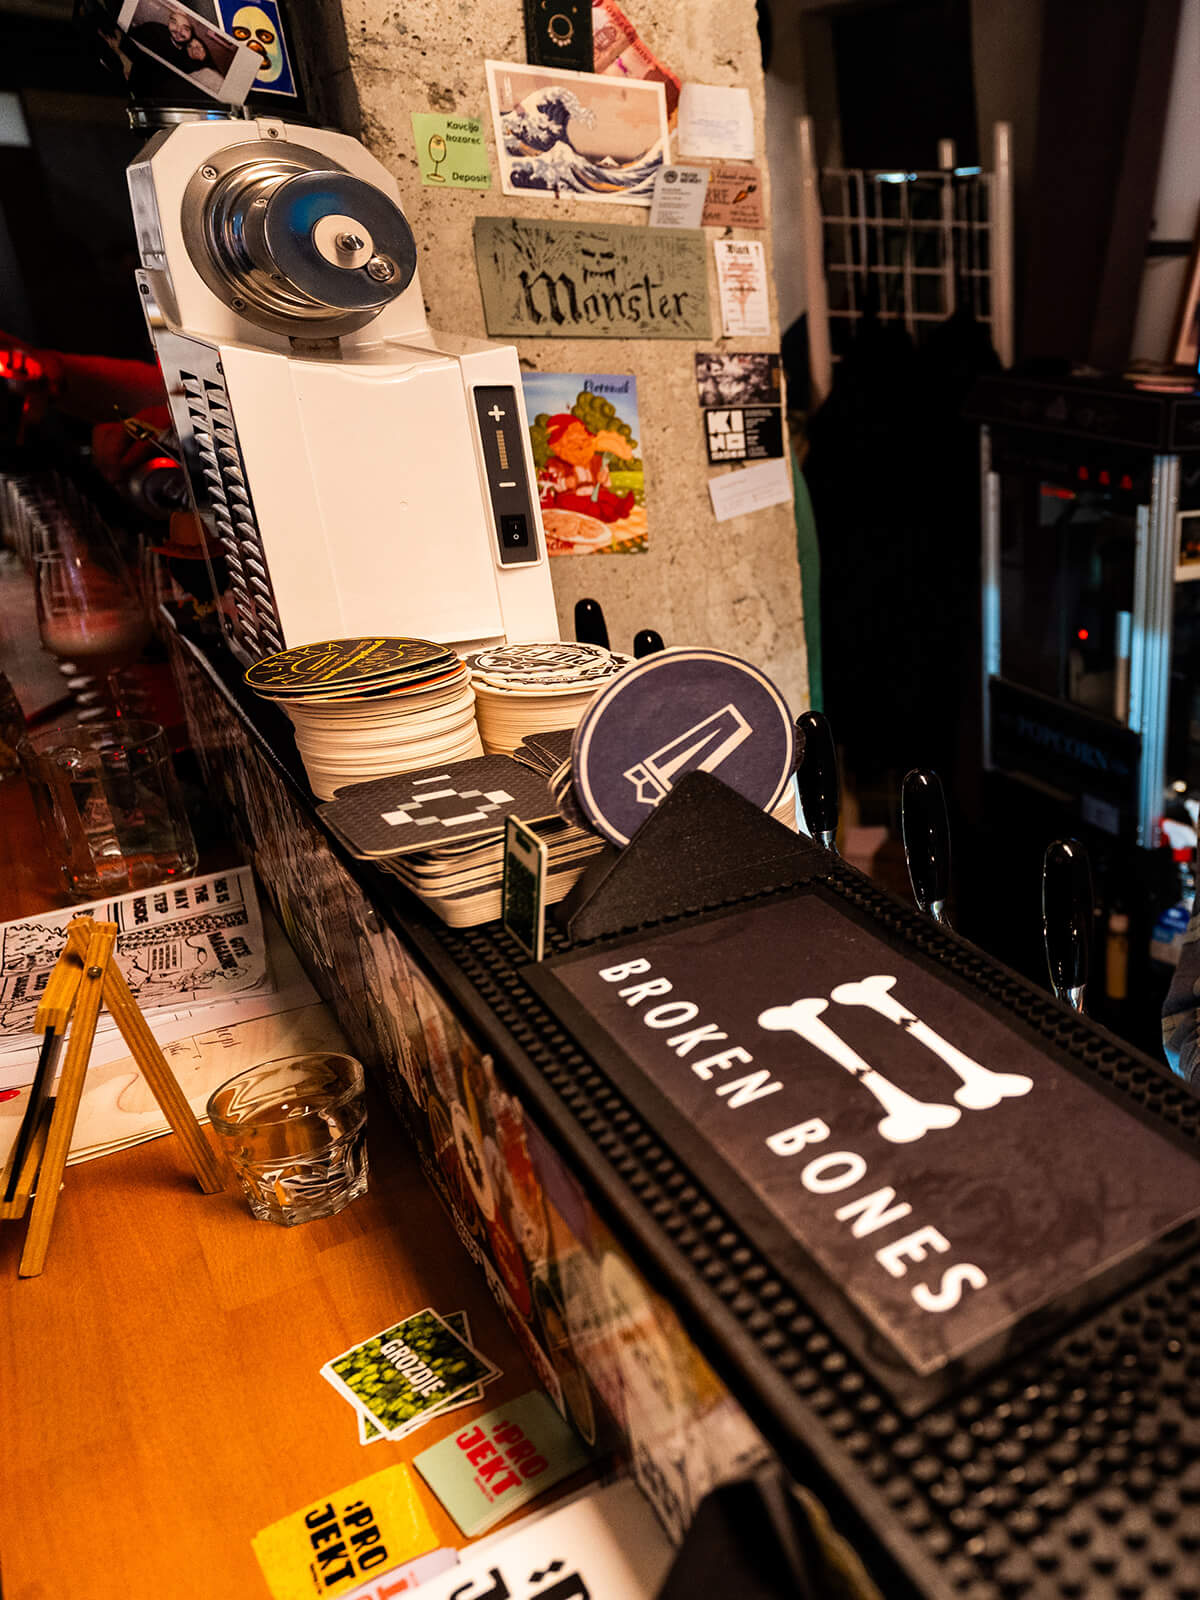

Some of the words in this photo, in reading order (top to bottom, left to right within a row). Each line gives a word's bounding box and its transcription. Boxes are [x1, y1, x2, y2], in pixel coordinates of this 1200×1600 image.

[452, 172, 488, 183] Deposit
[174, 888, 190, 910] WAY
[598, 957, 784, 1110] BROKEN
[765, 1117, 989, 1313] BONES
[379, 1338, 447, 1398] GROZDJE
[455, 1425, 523, 1497] JEKT
[304, 1502, 356, 1587] JEKT
